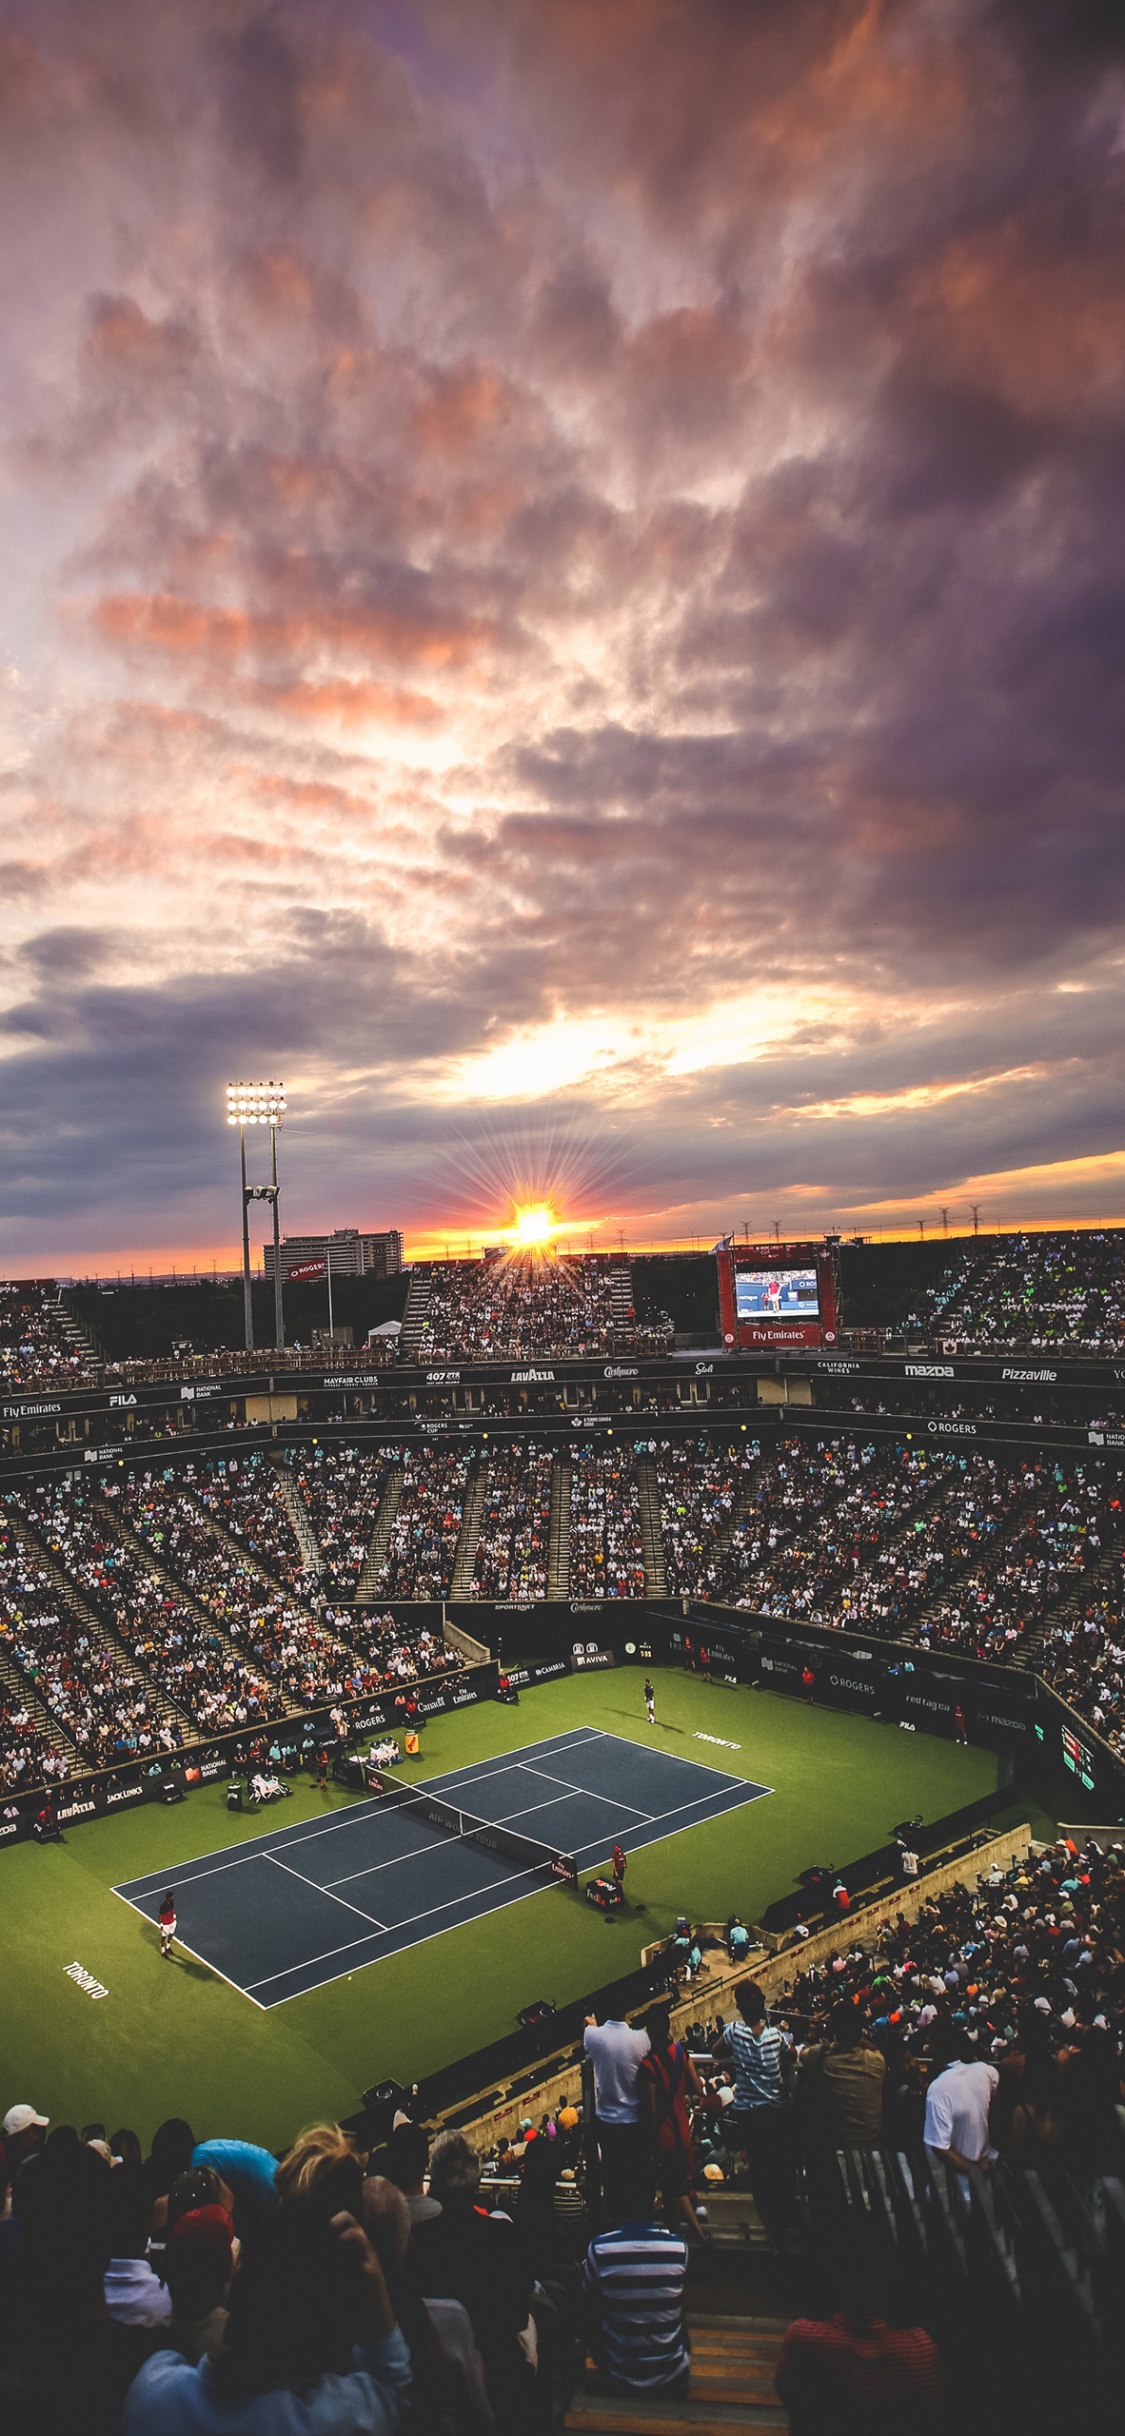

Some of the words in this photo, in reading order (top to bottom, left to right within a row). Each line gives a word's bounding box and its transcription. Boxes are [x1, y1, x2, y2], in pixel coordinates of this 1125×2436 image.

[752, 1331, 767, 1341] Fly
[767, 1330, 804, 1339] Emirates
[695, 1362, 714, 1375] Stoli
[817, 1361, 860, 1369] CALIFORNIA
[426, 1372, 446, 1381] 407
[511, 1368, 555, 1382] LAVAZZA
[1002, 1368, 1057, 1381] Pizzaville
[196, 1384, 221, 1392] NATIONAL
[109, 1394, 137, 1407] FILA
[3, 1407, 20, 1418] Fly
[20, 1403, 61, 1415] Emirates
[938, 1422, 977, 1434] ROGERS
[98, 1447, 124, 1455] NATIONAL
[586, 1655, 608, 1664] AVIVA
[540, 1662, 566, 1675] CAMBRIA
[724, 1674, 737, 1684] FILA
[840, 1678, 875, 1695] ROGERS
[452, 1691, 478, 1704] Emirates
[417, 1696, 446, 1713] Canada
[355, 1714, 386, 1730] ROGERS
[899, 1721, 916, 1731] FILA
[692, 1731, 742, 1750] TORONTO
[200, 1759, 227, 1771] NATIONAL
[202, 1767, 218, 1778] BANK
[107, 1791, 124, 1804] JACK
[123, 1786, 143, 1798] LINKS
[57, 1801, 96, 1820] LAVAZZA
[428, 1812, 443, 1824] ATP
[475, 1833, 498, 1850] TOUR
[586, 1888, 606, 1907] FedEx
[62, 1961, 110, 1999] TORONTO
